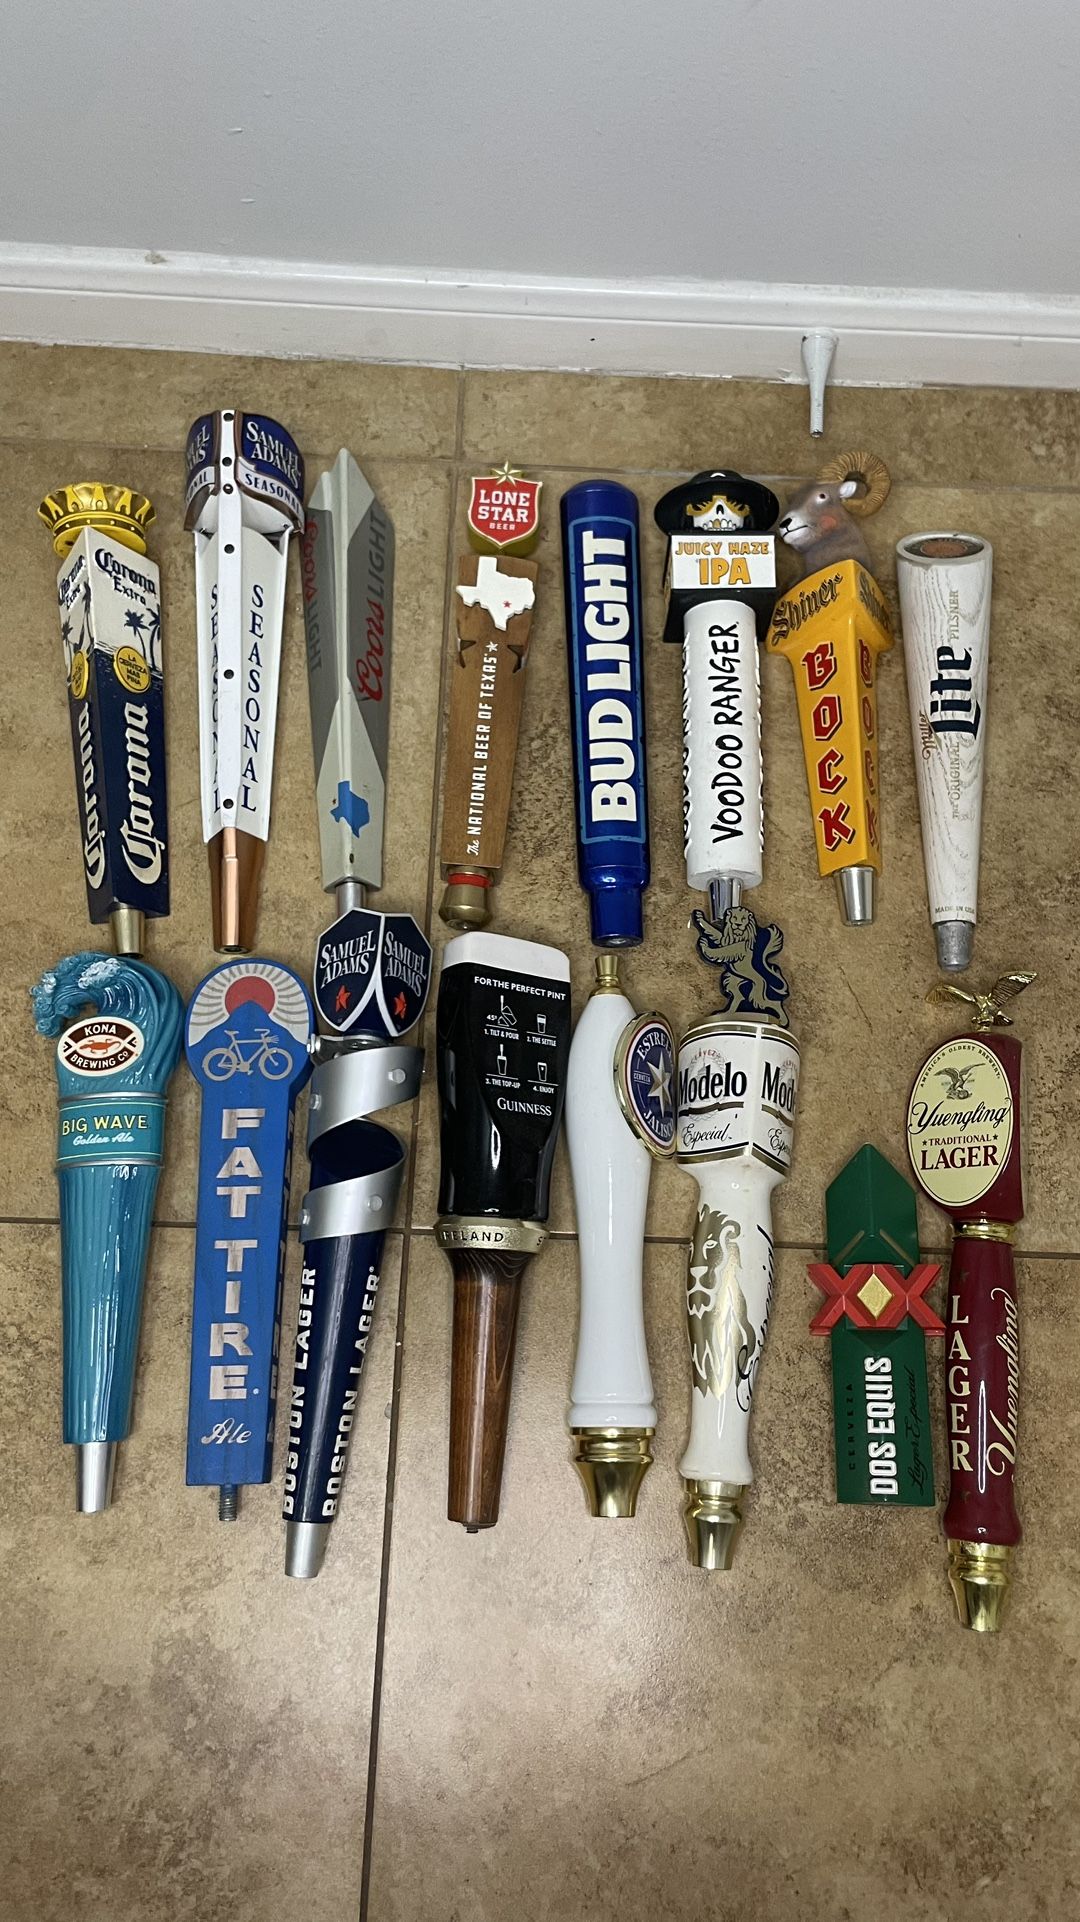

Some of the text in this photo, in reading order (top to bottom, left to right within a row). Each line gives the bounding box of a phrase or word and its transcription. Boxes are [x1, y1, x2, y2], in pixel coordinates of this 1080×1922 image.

[246, 421, 299, 467] SAMUEL
[250, 443, 299, 489] ADAMS
[477, 505, 529, 523] STAR
[479, 489, 531, 507] LONE
[489, 522, 516, 531] BEER
[675, 541, 770, 557] JUICY HAZE
[95, 548, 157, 595] Corona
[113, 576, 146, 606] Extra
[698, 556, 752, 586] IPA
[356, 510, 388, 702] Coors LIGHT
[771, 572, 844, 647] Shiner
[949, 590, 960, 641] PILSNER
[240, 584, 265, 813] SEASONAL
[582, 529, 638, 823] BUD LIGHT
[929, 646, 981, 741] Lite
[466, 655, 498, 856] The NATIONAL BEER OF TEXAS
[707, 621, 743, 845] VOODOO RANGER
[801, 639, 856, 852] BOCK
[919, 712, 939, 760] Miller
[119, 702, 166, 885] Corona
[949, 741, 960, 801] ORIGINAL
[78, 702, 106, 889] Corona
[320, 930, 376, 969] SAMUEL
[320, 952, 370, 990] ADAMS
[384, 931, 427, 980] SAMUEL
[384, 956, 423, 998] ADAMS
[474, 976, 566, 1001] FOR THE PERFECT PINT
[83, 1023, 117, 1036] KONA
[490, 1028, 501, 1037] TILT
[532, 1036, 541, 1044] THE
[70, 1053, 116, 1069] BREWING
[491, 1078, 502, 1087] THE
[920, 1052, 946, 1088] AMERICA'S
[948, 1044, 976, 1054] OLDEST
[496, 1097, 552, 1117] GUINNESS
[539, 1086, 555, 1094] ENJOY
[679, 1061, 748, 1108] Modelo
[62, 1115, 148, 1136] BIG WAVE
[73, 1131, 135, 1146] Golden Ale
[907, 1097, 1012, 1135] Yuengling
[920, 1144, 999, 1171] LAGER
[928, 1133, 992, 1147] TRADITIONAL
[209, 1108, 266, 1401] FAT TIRE
[294, 1267, 317, 1371] LAGER
[321, 1272, 381, 1517] BOSTON LAGER
[948, 1294, 974, 1472] LAGER
[200, 1417, 252, 1445] Ale
[847, 1383, 856, 1471] CERVEZA
[863, 1356, 899, 1496] DOS EQUIS
